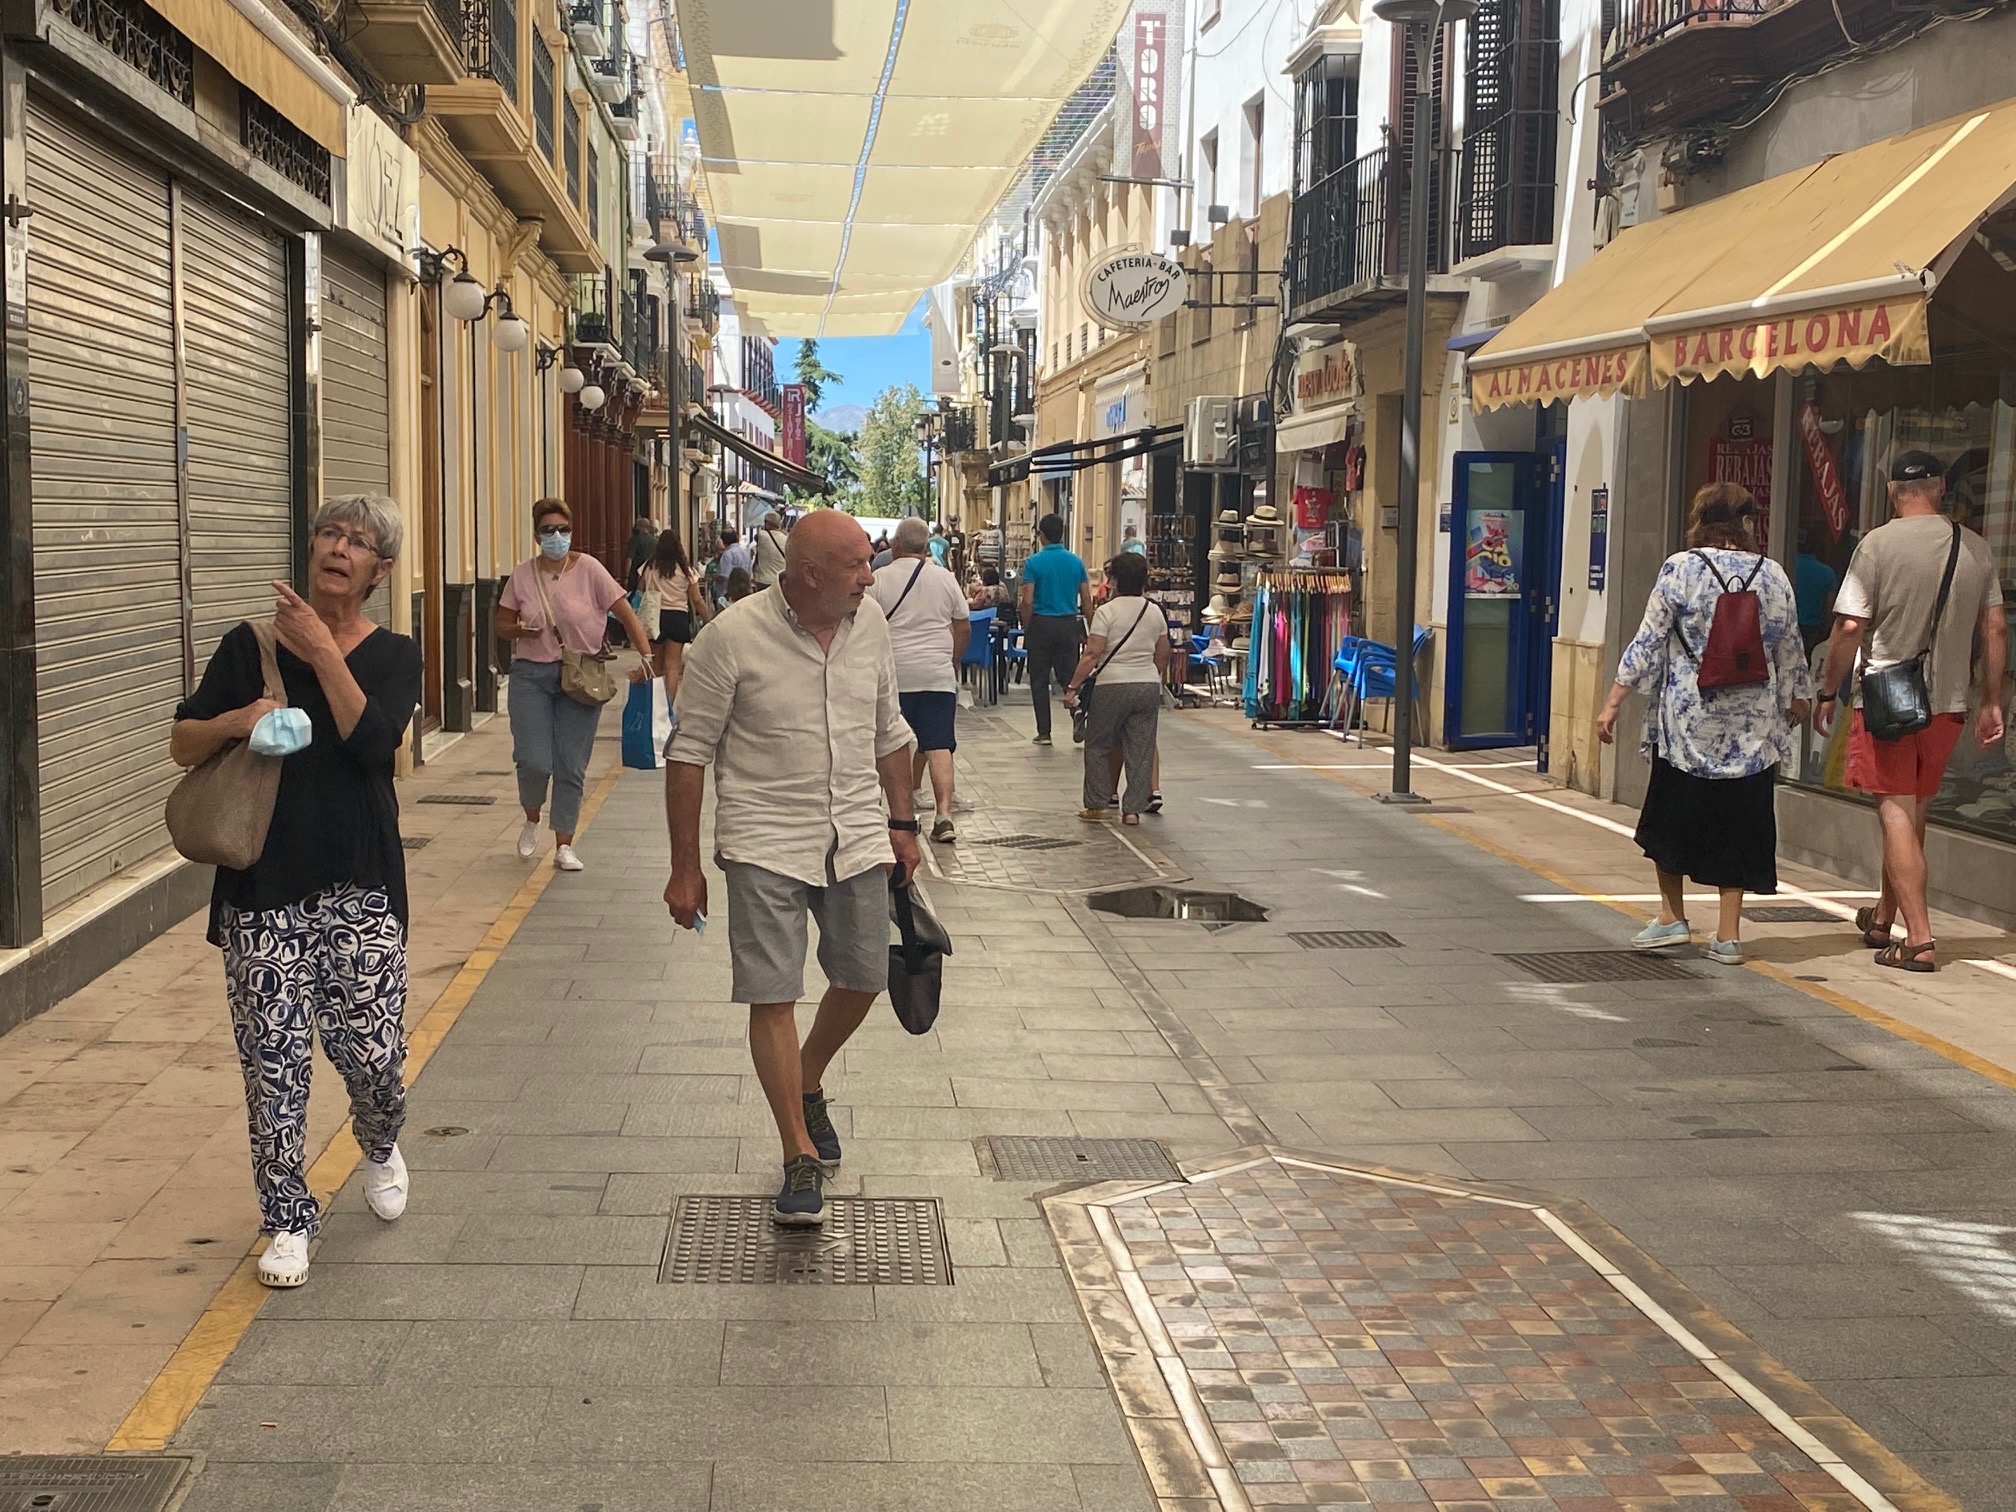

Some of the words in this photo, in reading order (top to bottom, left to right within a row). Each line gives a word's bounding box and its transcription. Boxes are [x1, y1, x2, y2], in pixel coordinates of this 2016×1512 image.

[1139, 20, 1161, 130] TORO
[1674, 304, 1891, 368] BARCELONA
[1488, 351, 1628, 398] ALMACENES
